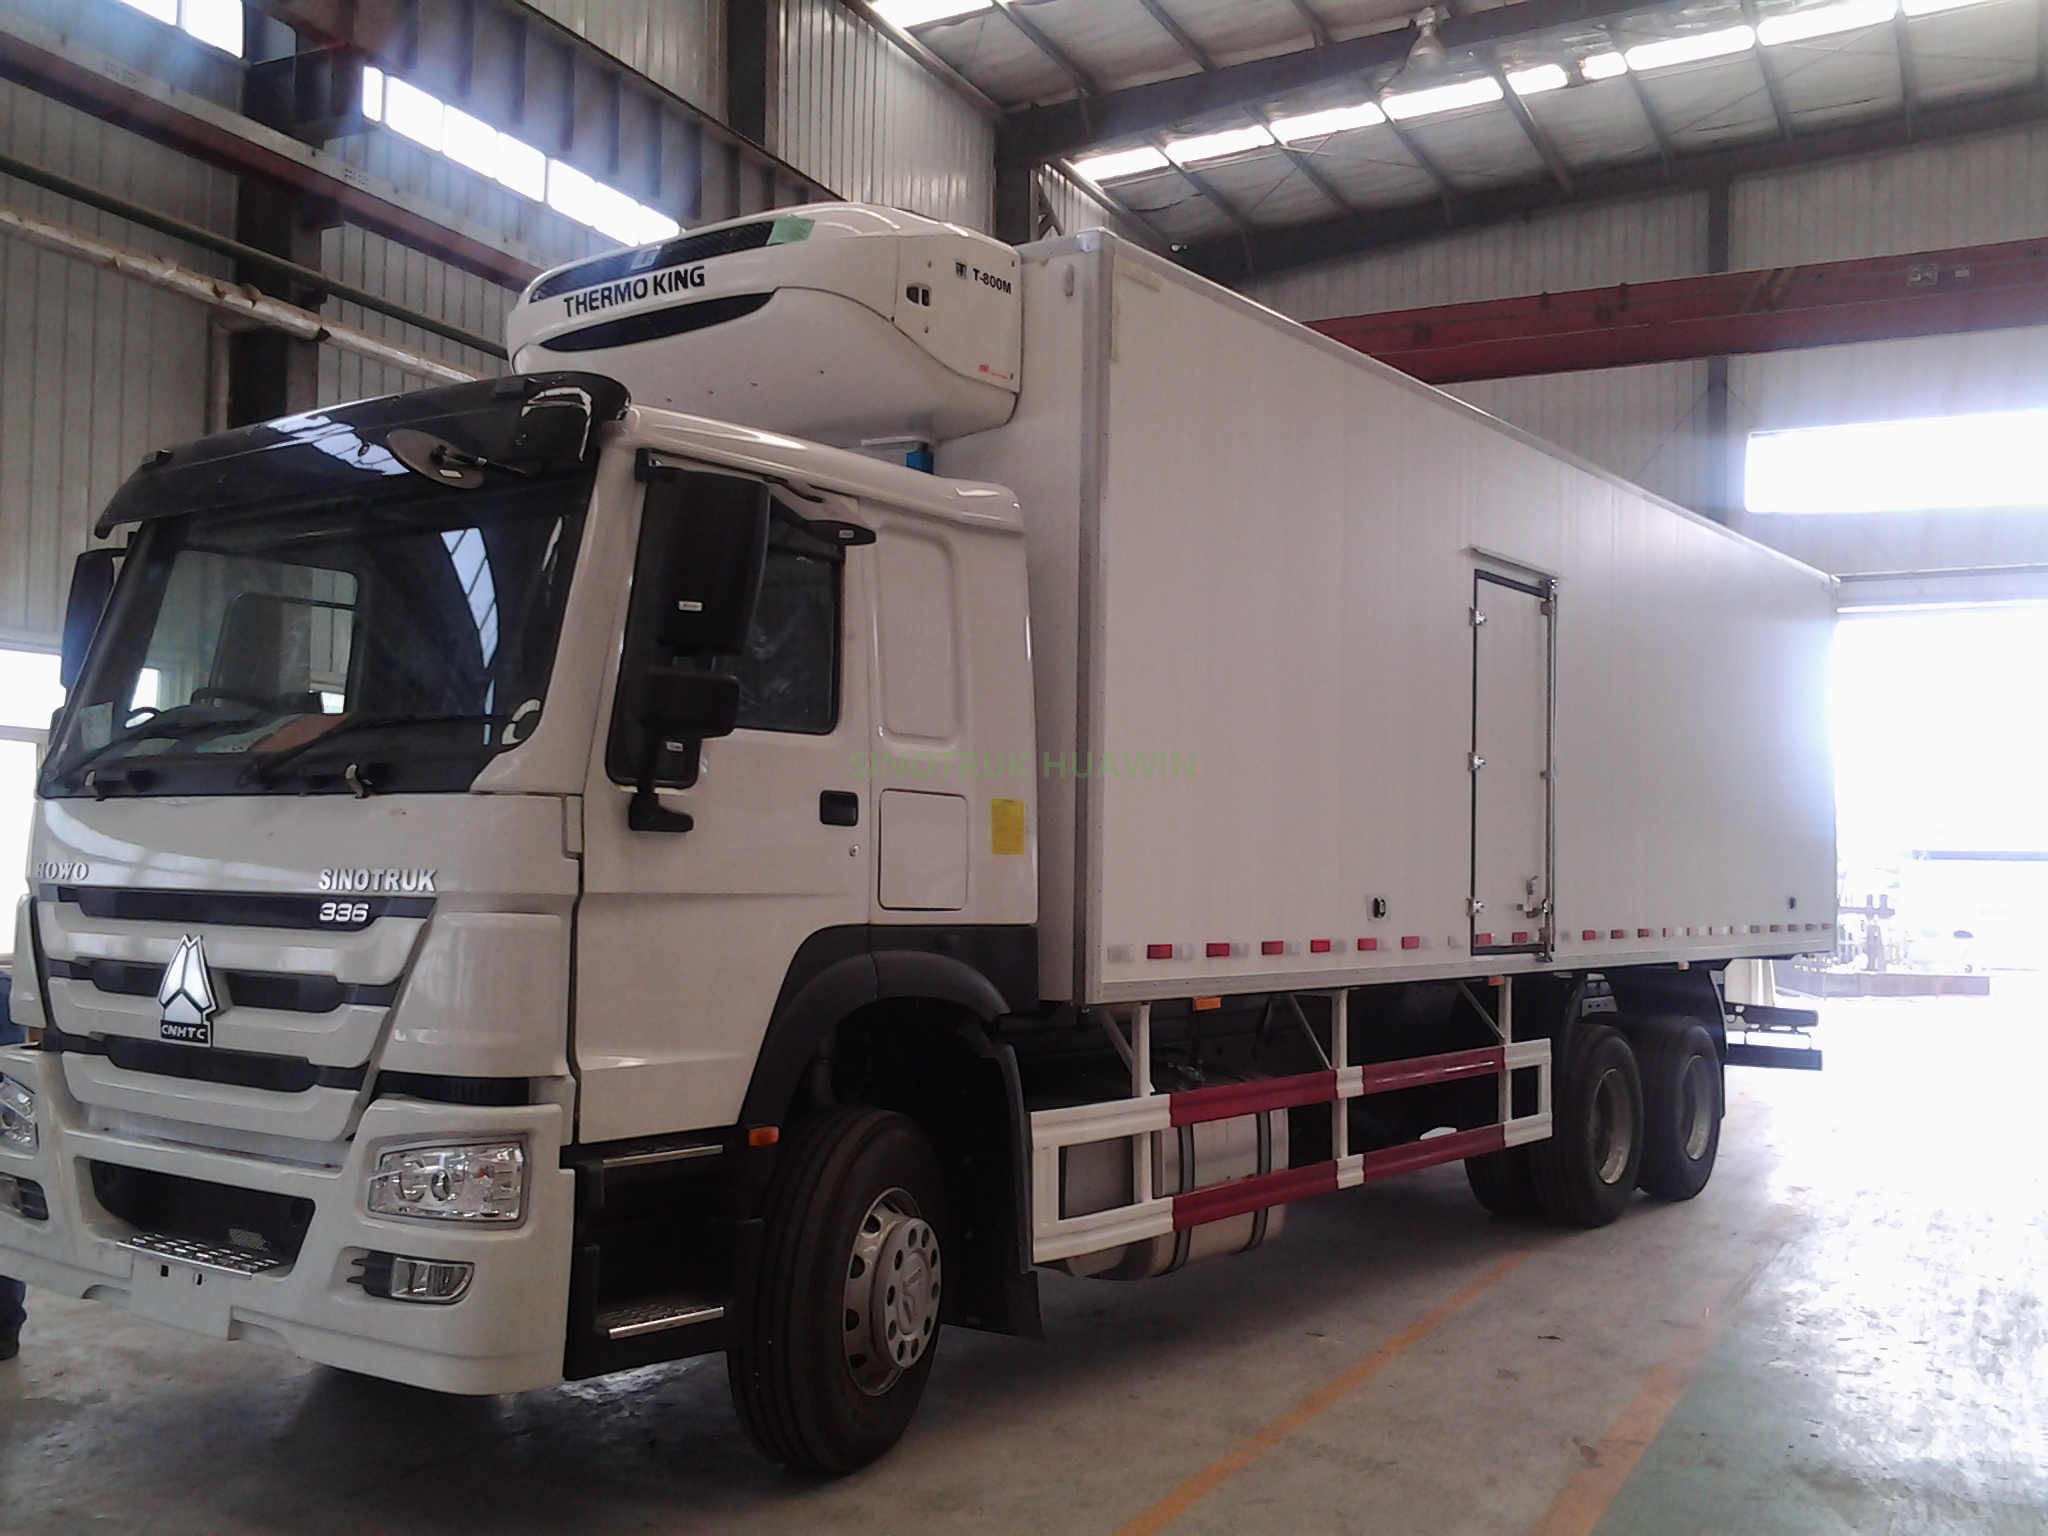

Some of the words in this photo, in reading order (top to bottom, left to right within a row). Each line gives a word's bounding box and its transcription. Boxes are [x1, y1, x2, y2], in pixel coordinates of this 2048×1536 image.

[563, 277, 648, 318] THERMO
[653, 266, 706, 295] KING
[972, 267, 1012, 295] T-800M
[318, 867, 437, 892] SINOTRUK
[319, 902, 370, 922] 336
[161, 1024, 207, 1040] CNHTC
